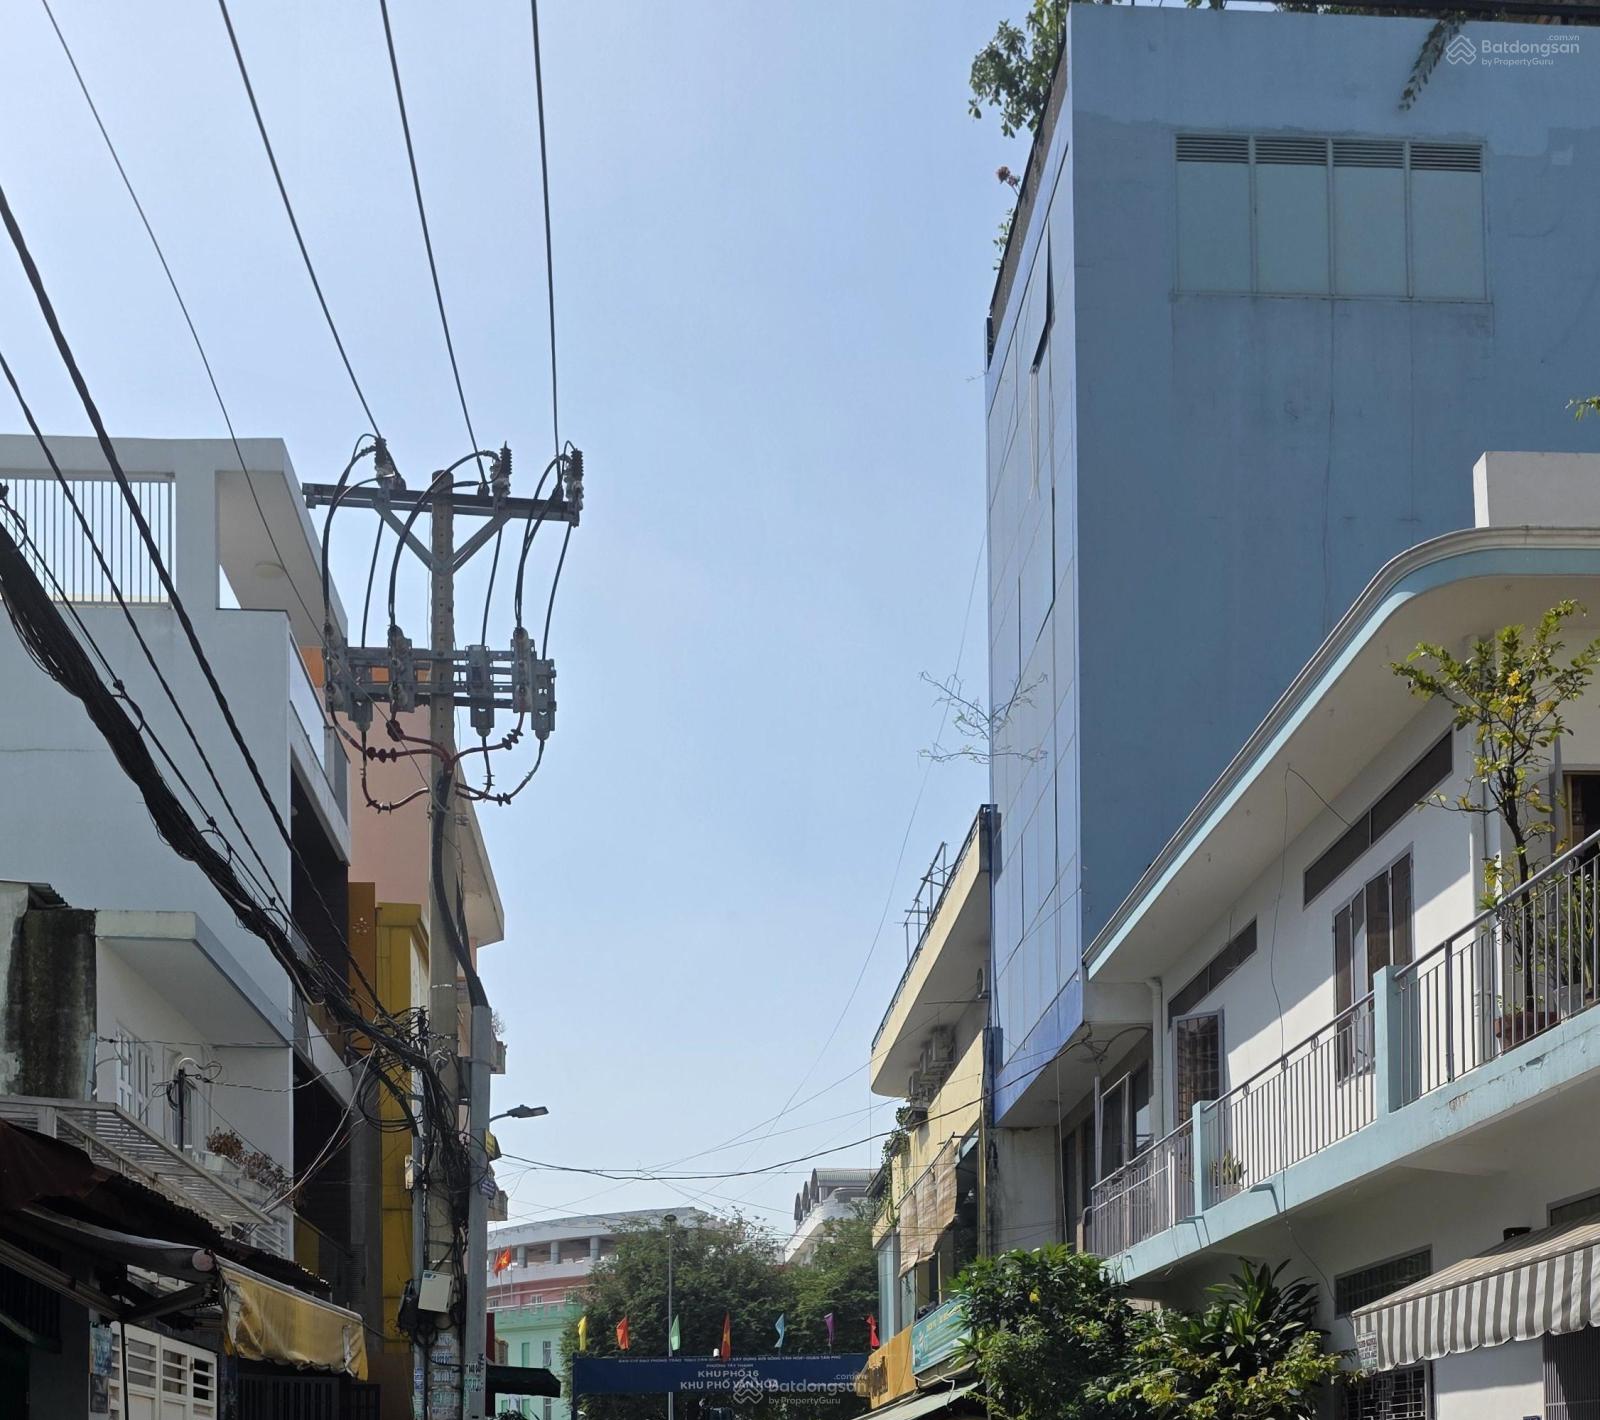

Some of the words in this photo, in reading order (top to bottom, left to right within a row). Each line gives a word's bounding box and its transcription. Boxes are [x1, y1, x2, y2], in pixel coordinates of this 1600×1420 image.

[697, 1370, 721, 1378] KHU
[722, 1367, 746, 1378] PHỐ
[747, 1369, 759, 1377] 16
[680, 1381, 704, 1390] KHU
[706, 1377, 731, 1390] PHỐ
